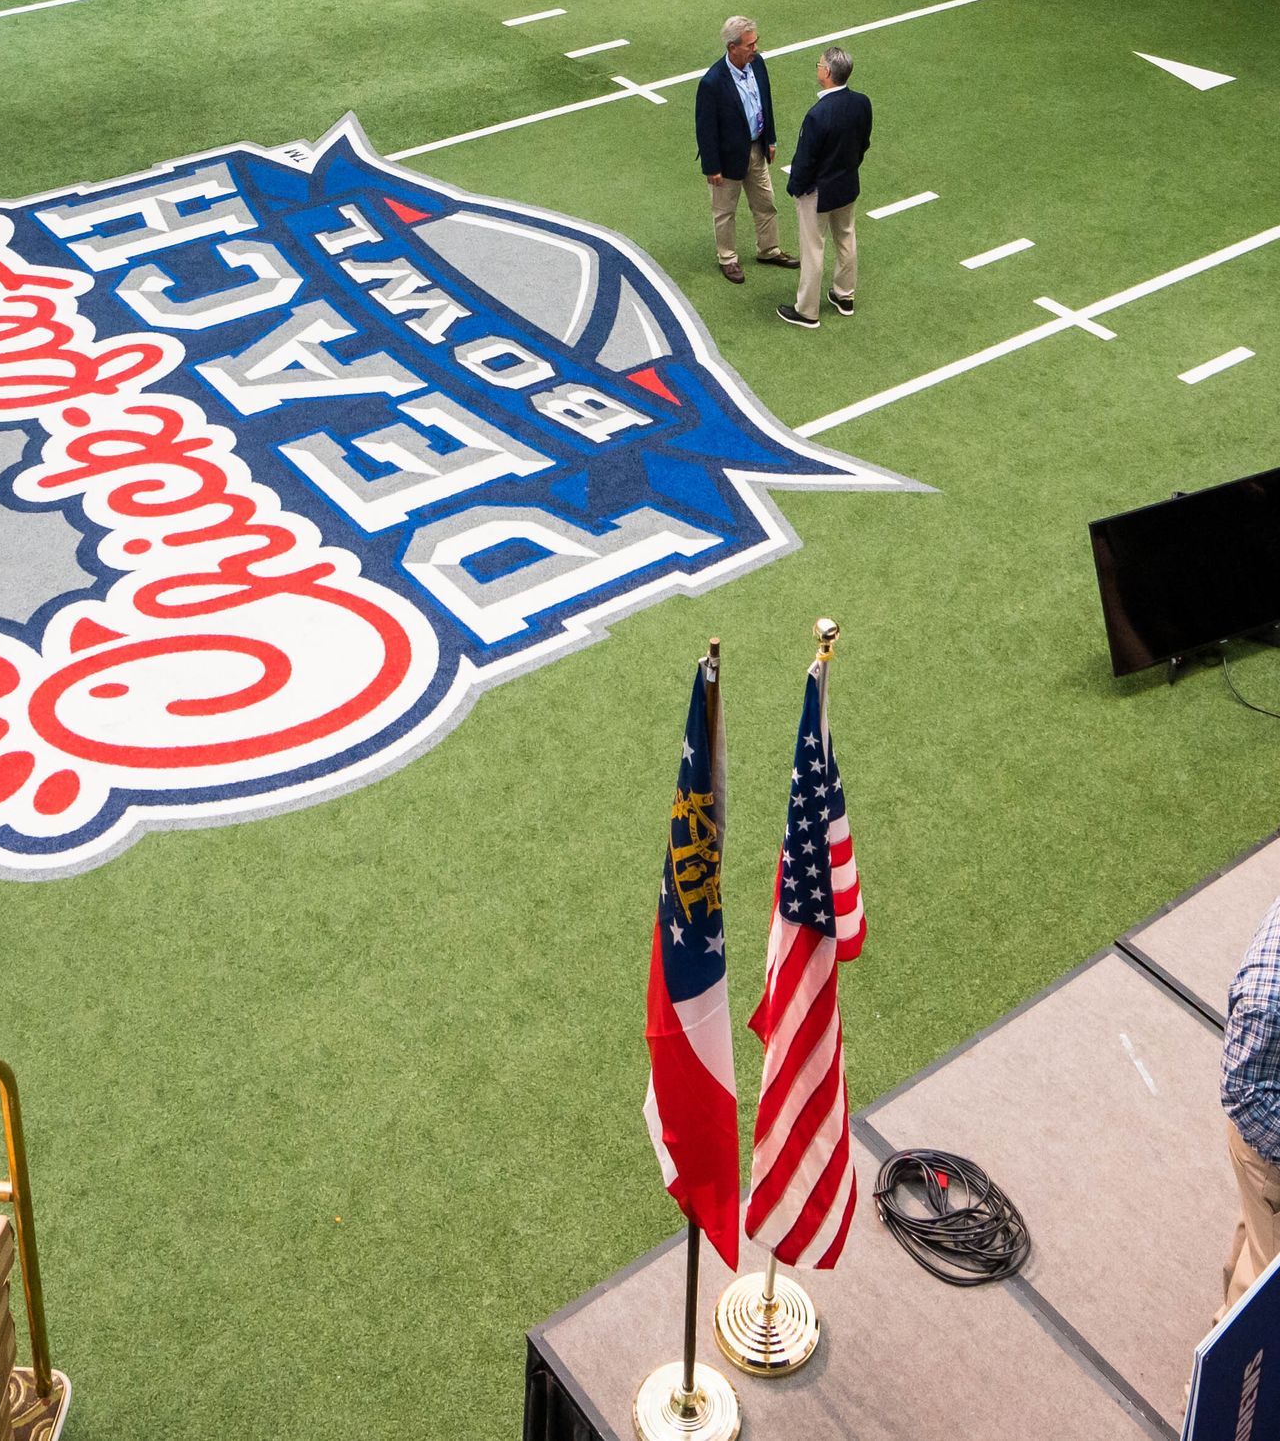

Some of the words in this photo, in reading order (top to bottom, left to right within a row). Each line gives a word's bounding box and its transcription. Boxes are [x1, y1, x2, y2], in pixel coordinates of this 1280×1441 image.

[33, 160, 725, 646] PEACH
[313, 202, 655, 445] BOWL
[1234, 1347, 1265, 1441] DREWS
